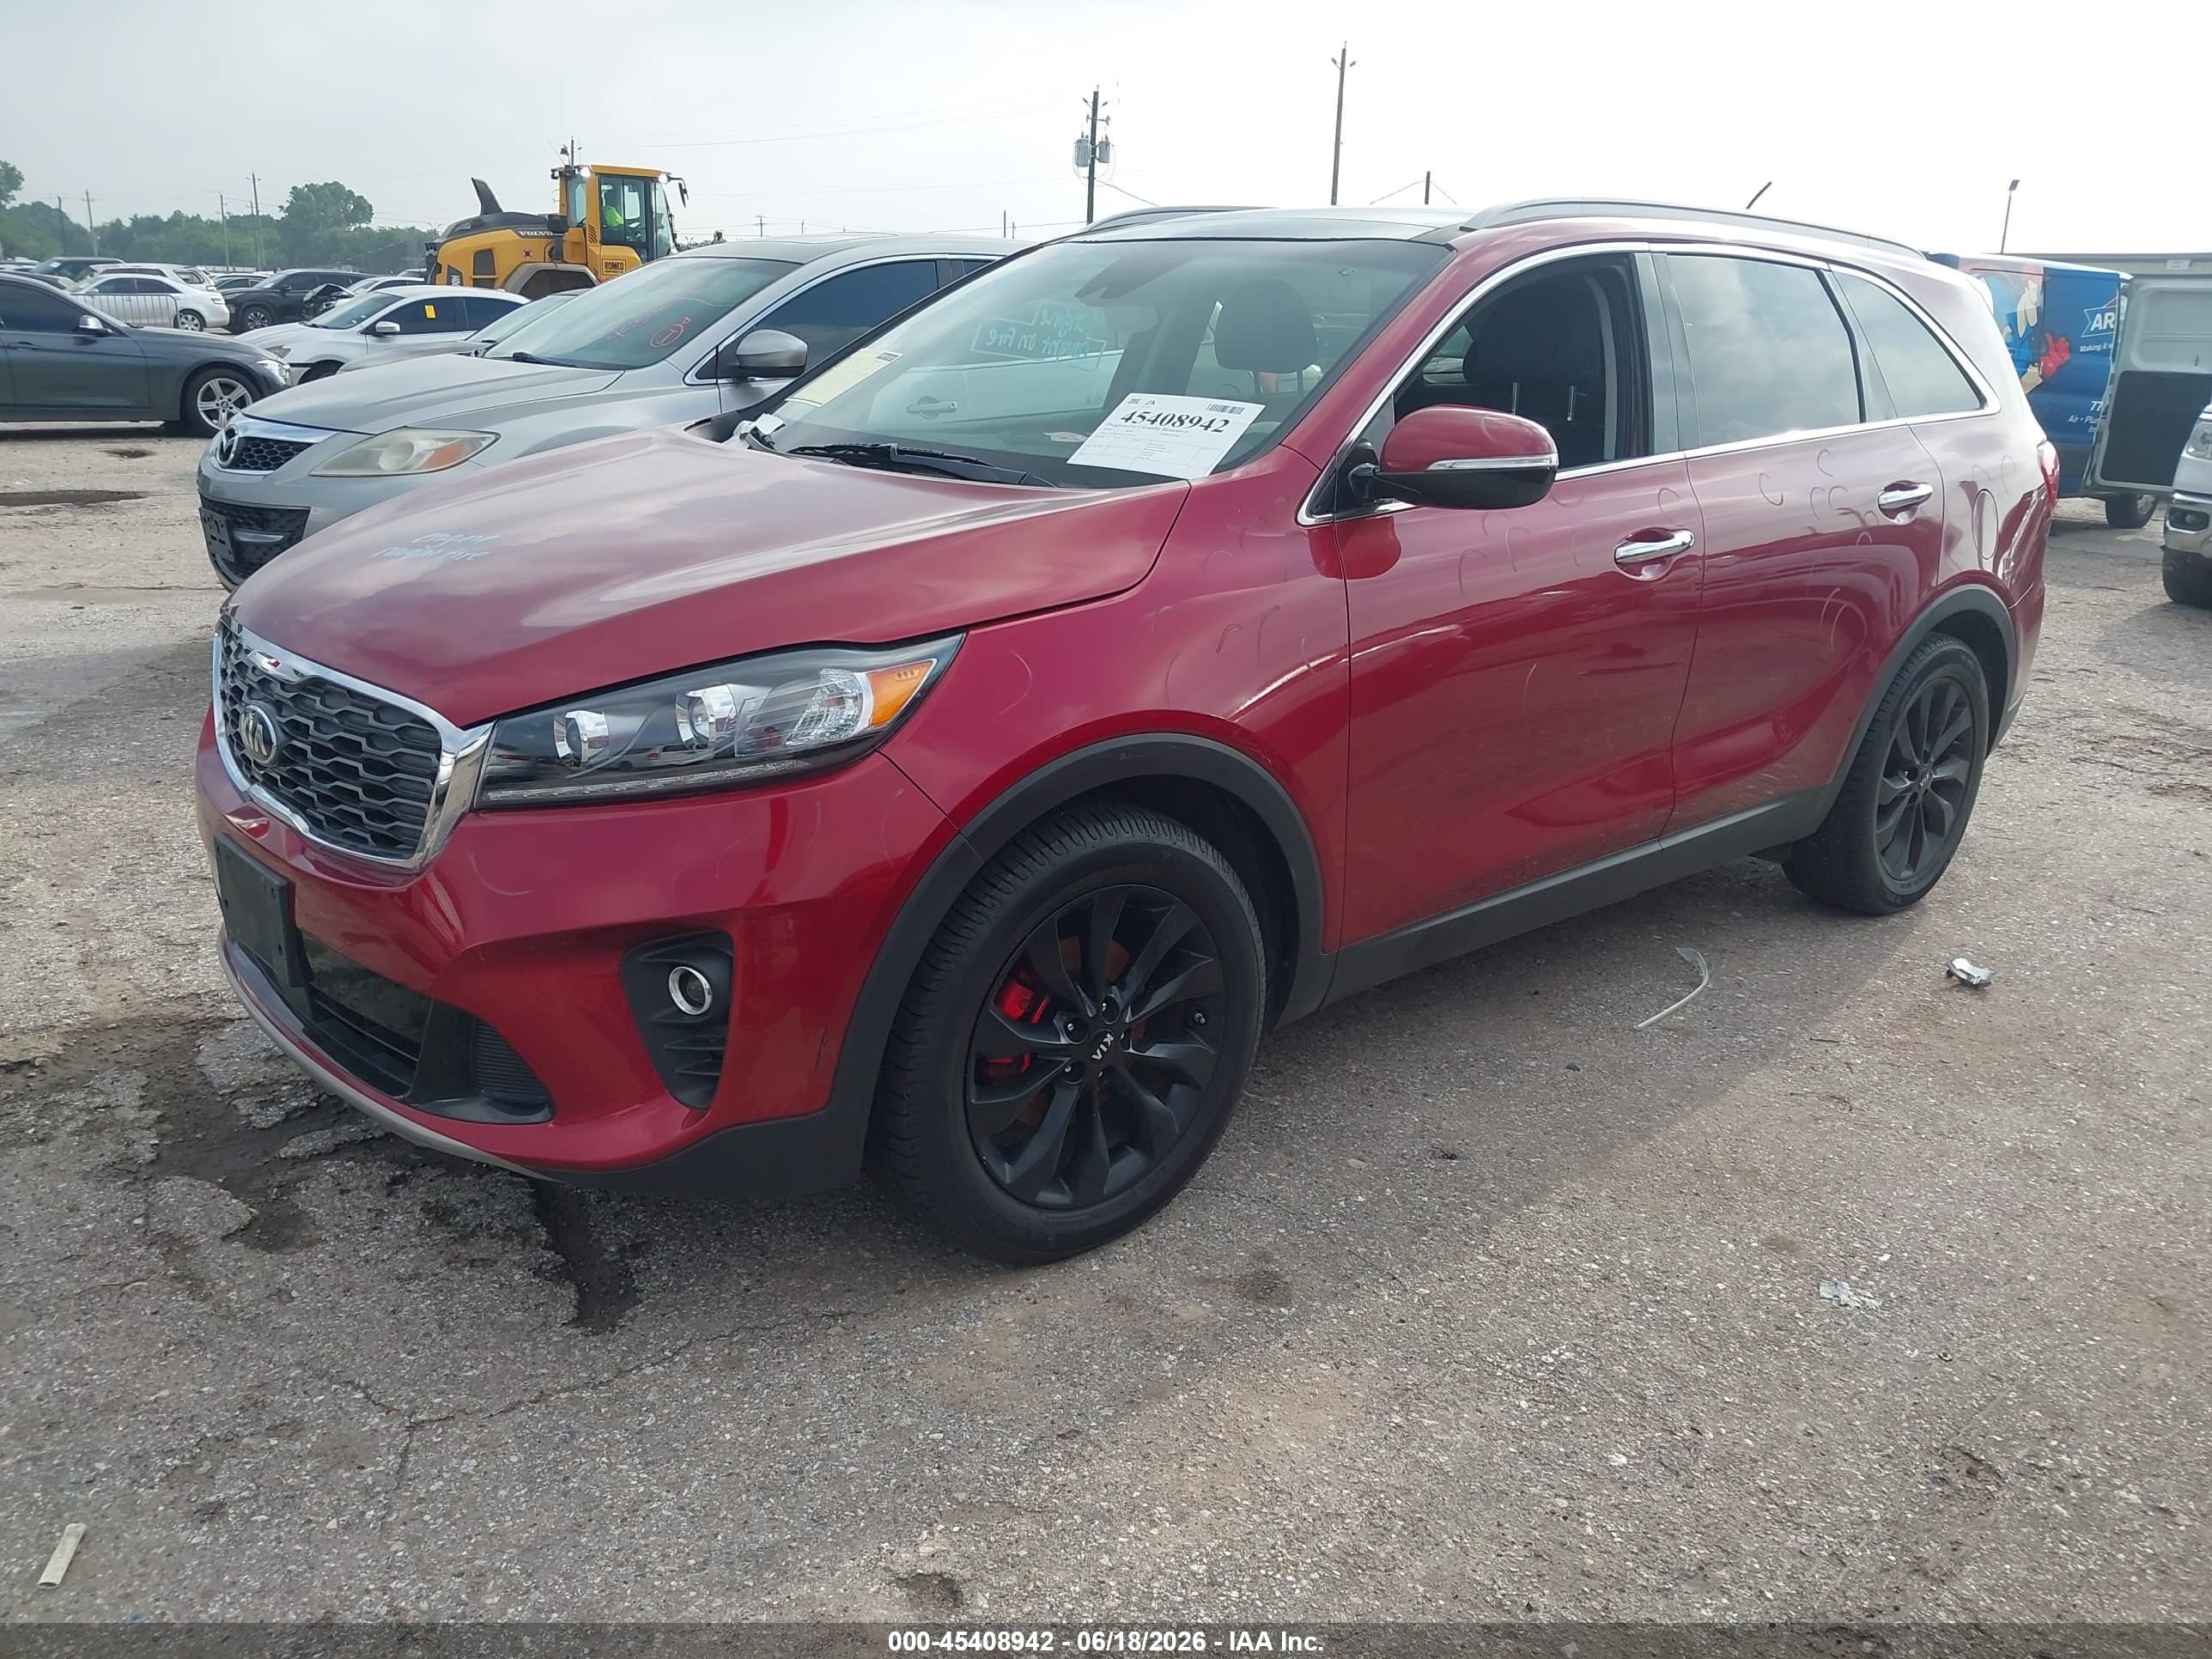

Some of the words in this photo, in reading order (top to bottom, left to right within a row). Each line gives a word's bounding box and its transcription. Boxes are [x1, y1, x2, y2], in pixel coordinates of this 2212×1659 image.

[604, 261, 624, 270] ROMCO
[1120, 410, 1231, 434] 45408942
[1091, 1032, 1115, 1060] KIA
